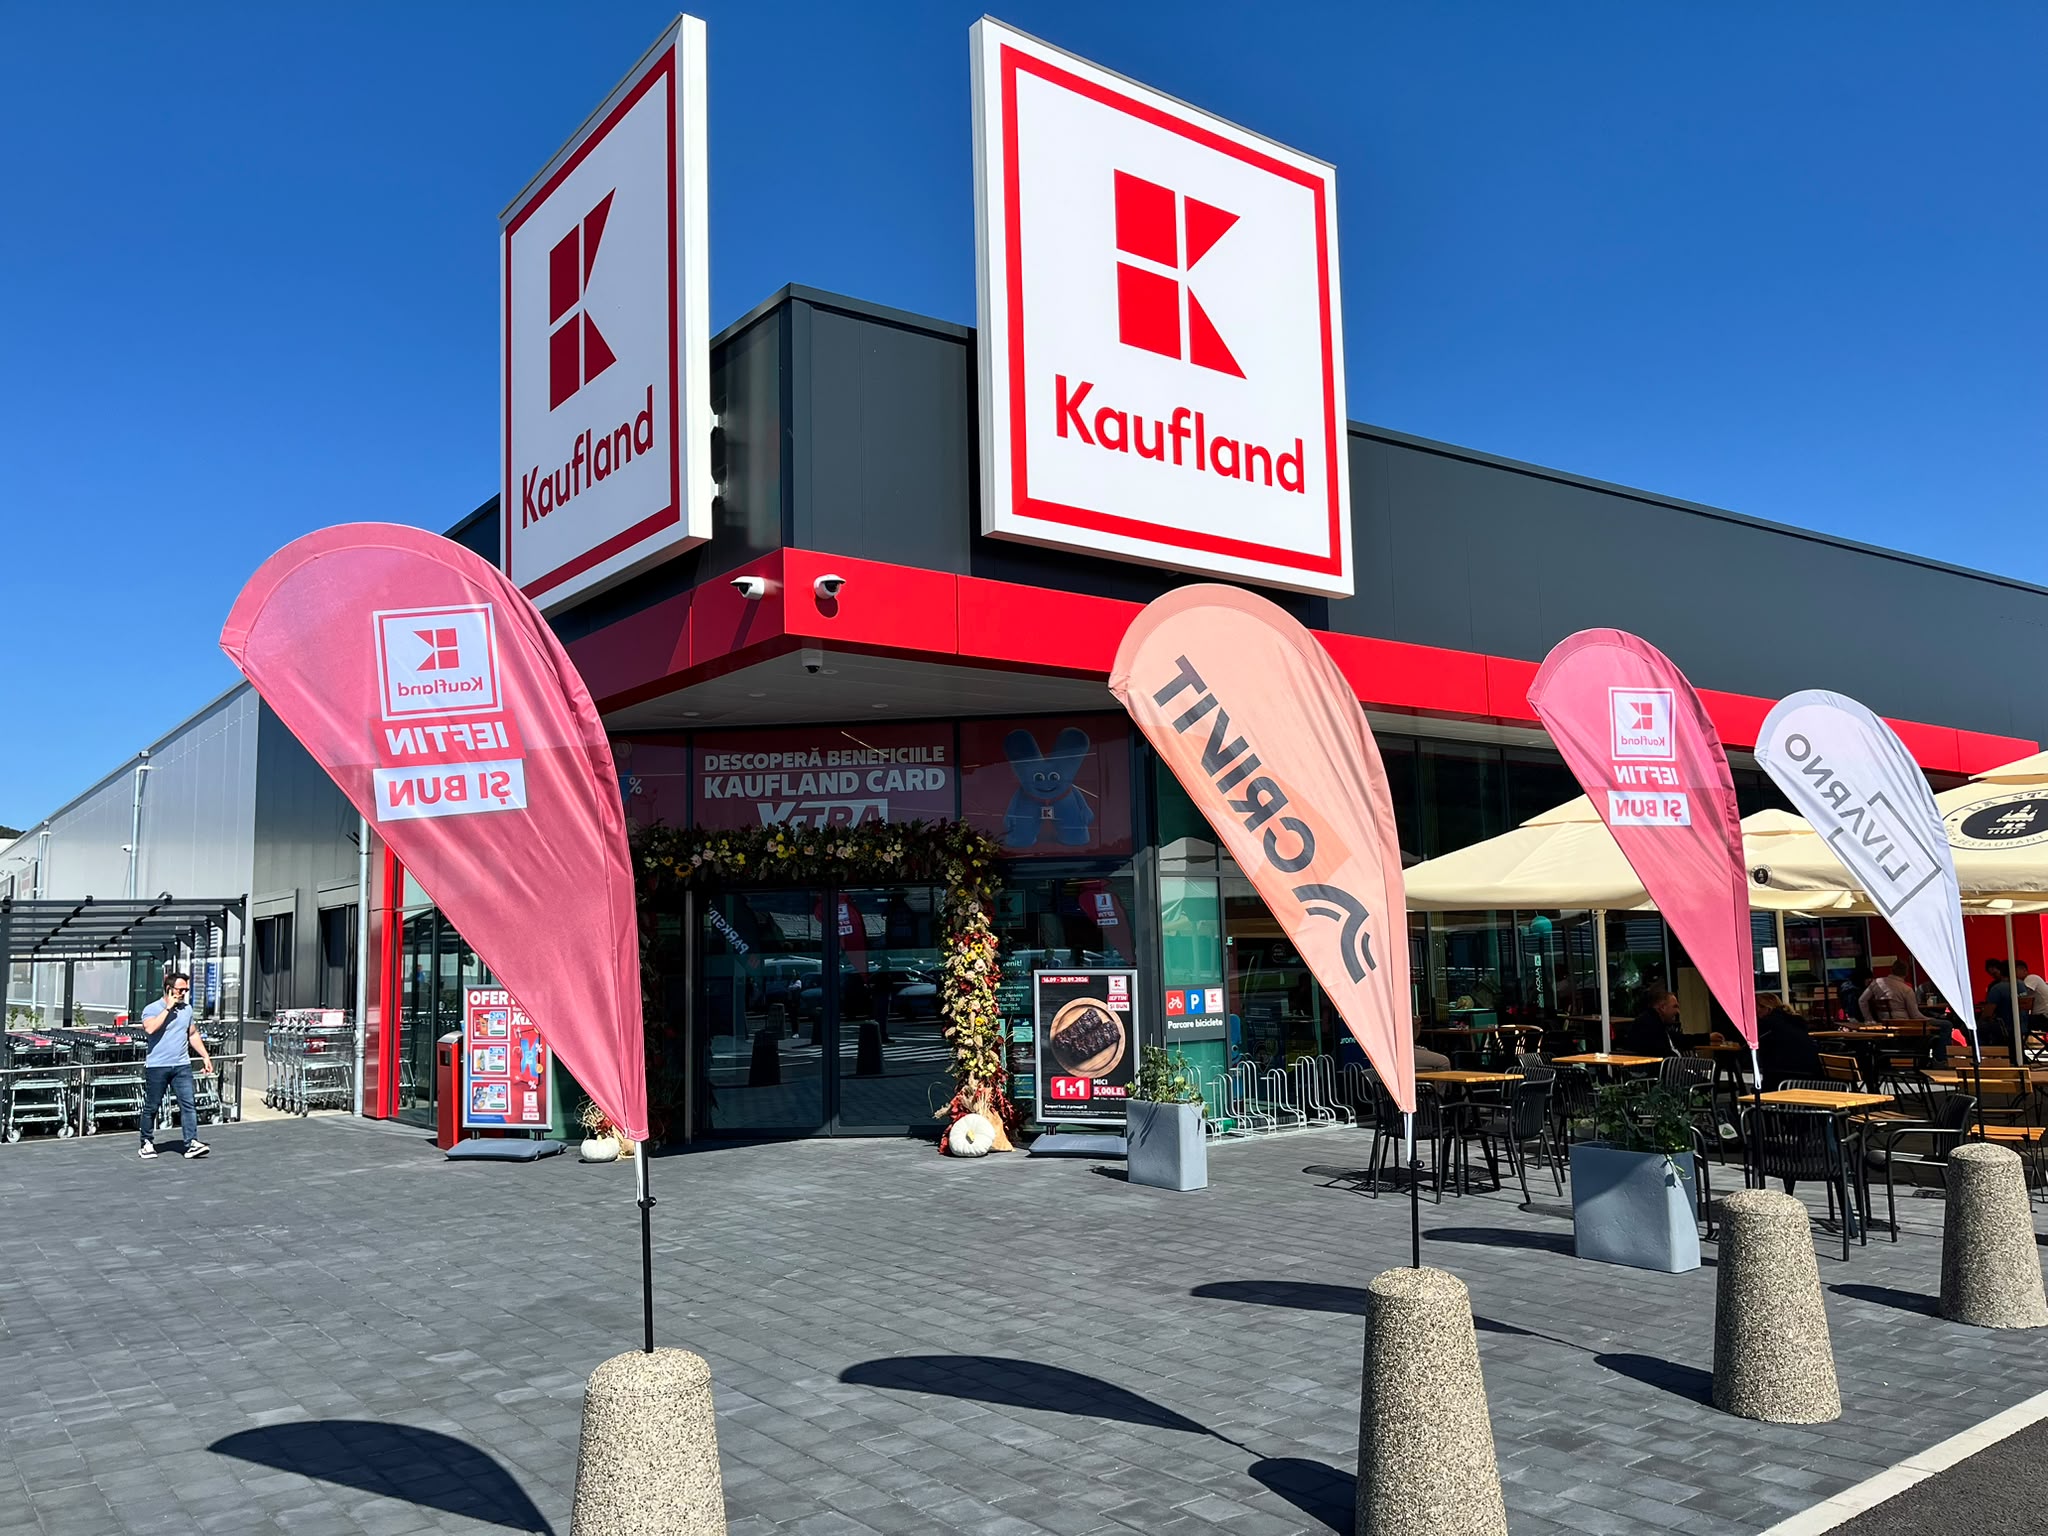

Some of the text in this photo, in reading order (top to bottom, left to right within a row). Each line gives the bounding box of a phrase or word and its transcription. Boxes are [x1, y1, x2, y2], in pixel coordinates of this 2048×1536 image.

[1055, 372, 1305, 495] Kaufland
[521, 384, 654, 529] Kaufland
[704, 746, 945, 771] DESCOPERĂ BENEFICIILE
[704, 768, 946, 799] KAUFLAND CARD
[1190, 993, 1200, 1010] P
[1168, 1018, 1223, 1030] Parcare biciclete
[1056, 1079, 1085, 1097] 1+1
